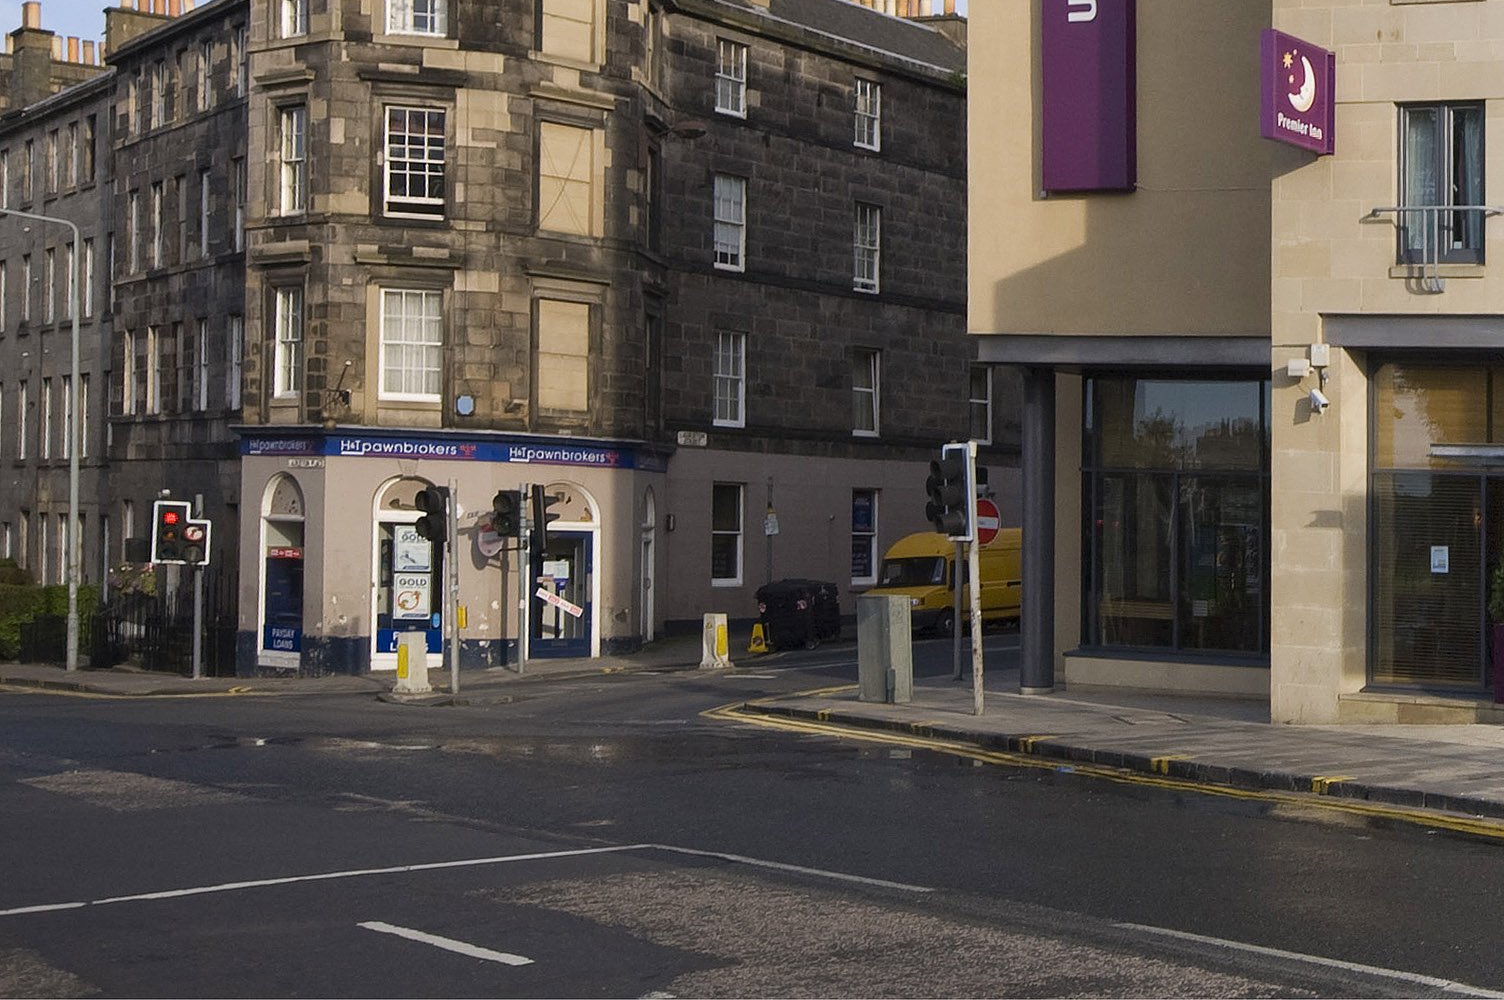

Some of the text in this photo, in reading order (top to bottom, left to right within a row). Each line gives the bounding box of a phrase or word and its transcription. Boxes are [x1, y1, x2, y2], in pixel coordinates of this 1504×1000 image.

[1277, 112, 1323, 140] Premier Inn
[399, 578, 427, 586] GOLD
